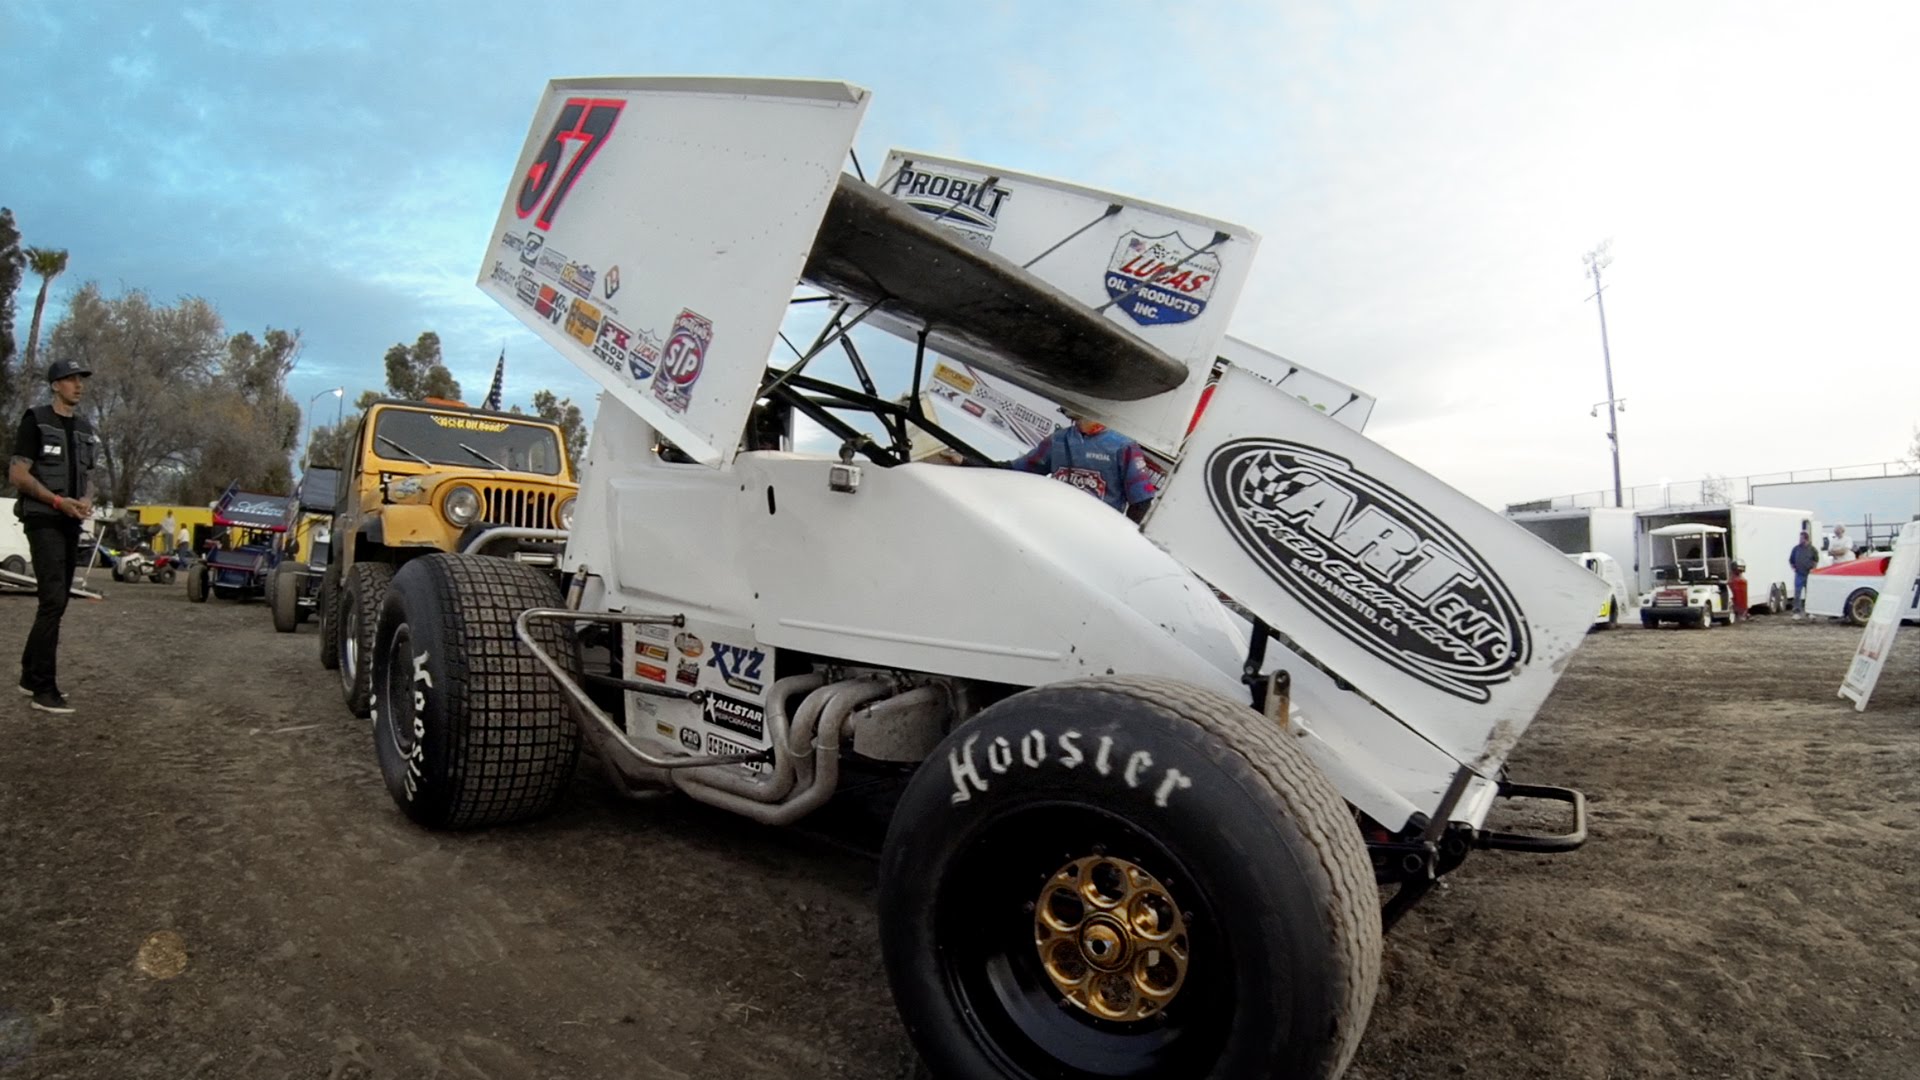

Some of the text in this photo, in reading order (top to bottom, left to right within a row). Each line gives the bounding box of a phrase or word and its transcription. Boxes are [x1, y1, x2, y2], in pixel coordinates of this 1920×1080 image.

[516, 97, 627, 231] 57
[892, 169, 1010, 219] PROBILT
[1107, 276, 1128, 292] OIL
[1119, 256, 1210, 293] LUCAS
[1133, 302, 1159, 319] INC.
[601, 321, 630, 351] FK
[602, 340, 625, 361] ROD
[593, 345, 622, 371] ENDS
[665, 338, 698, 376] STP
[1276, 478, 1480, 605] ART
[1239, 505, 1486, 666] SPEED EQUIPMENT
[1289, 557, 1400, 637] SACRAMENTO, CA
[706, 641, 766, 681] XYZ
[715, 699, 763, 723] ALLSTAR
[682, 729, 699, 746] PRO
[949, 728, 1192, 808] Hoosier
